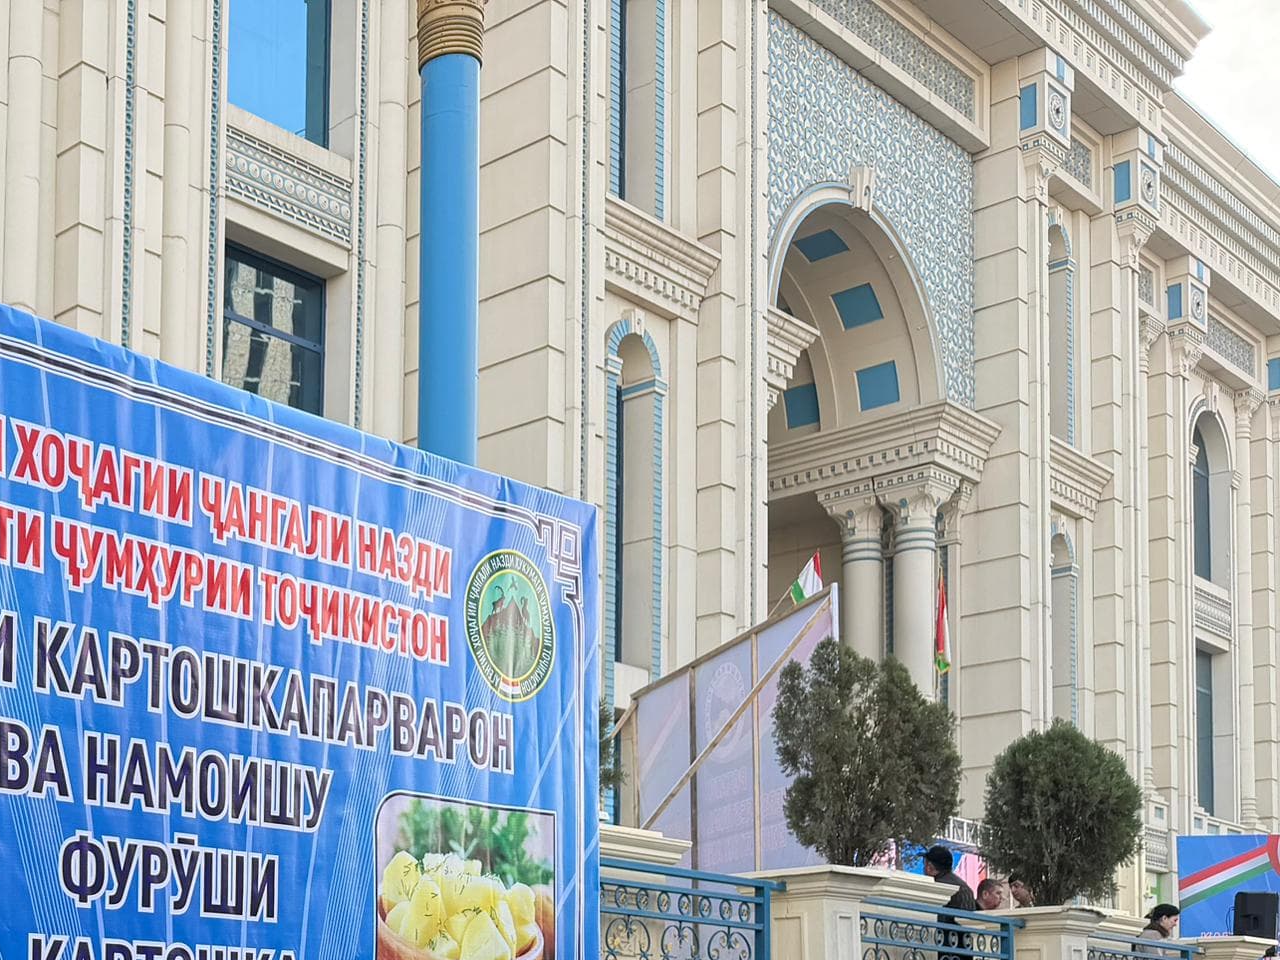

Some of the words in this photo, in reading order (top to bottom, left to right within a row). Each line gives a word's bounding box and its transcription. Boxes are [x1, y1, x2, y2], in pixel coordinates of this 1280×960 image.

[12, 425, 193, 522] ХОҶАГИИ
[202, 479, 350, 558] ҶАНГАЛИ
[358, 526, 452, 598] НАЗДИ
[53, 519, 251, 620] ҶУМҲУРИИ
[260, 572, 449, 665] ТОҶИКИСТОН
[36, 620, 515, 772] КАРТОШКАПАРВАРОН
[85, 734, 332, 831] НАМОИШУ
[62, 832, 278, 922] ФУРӮШИ
